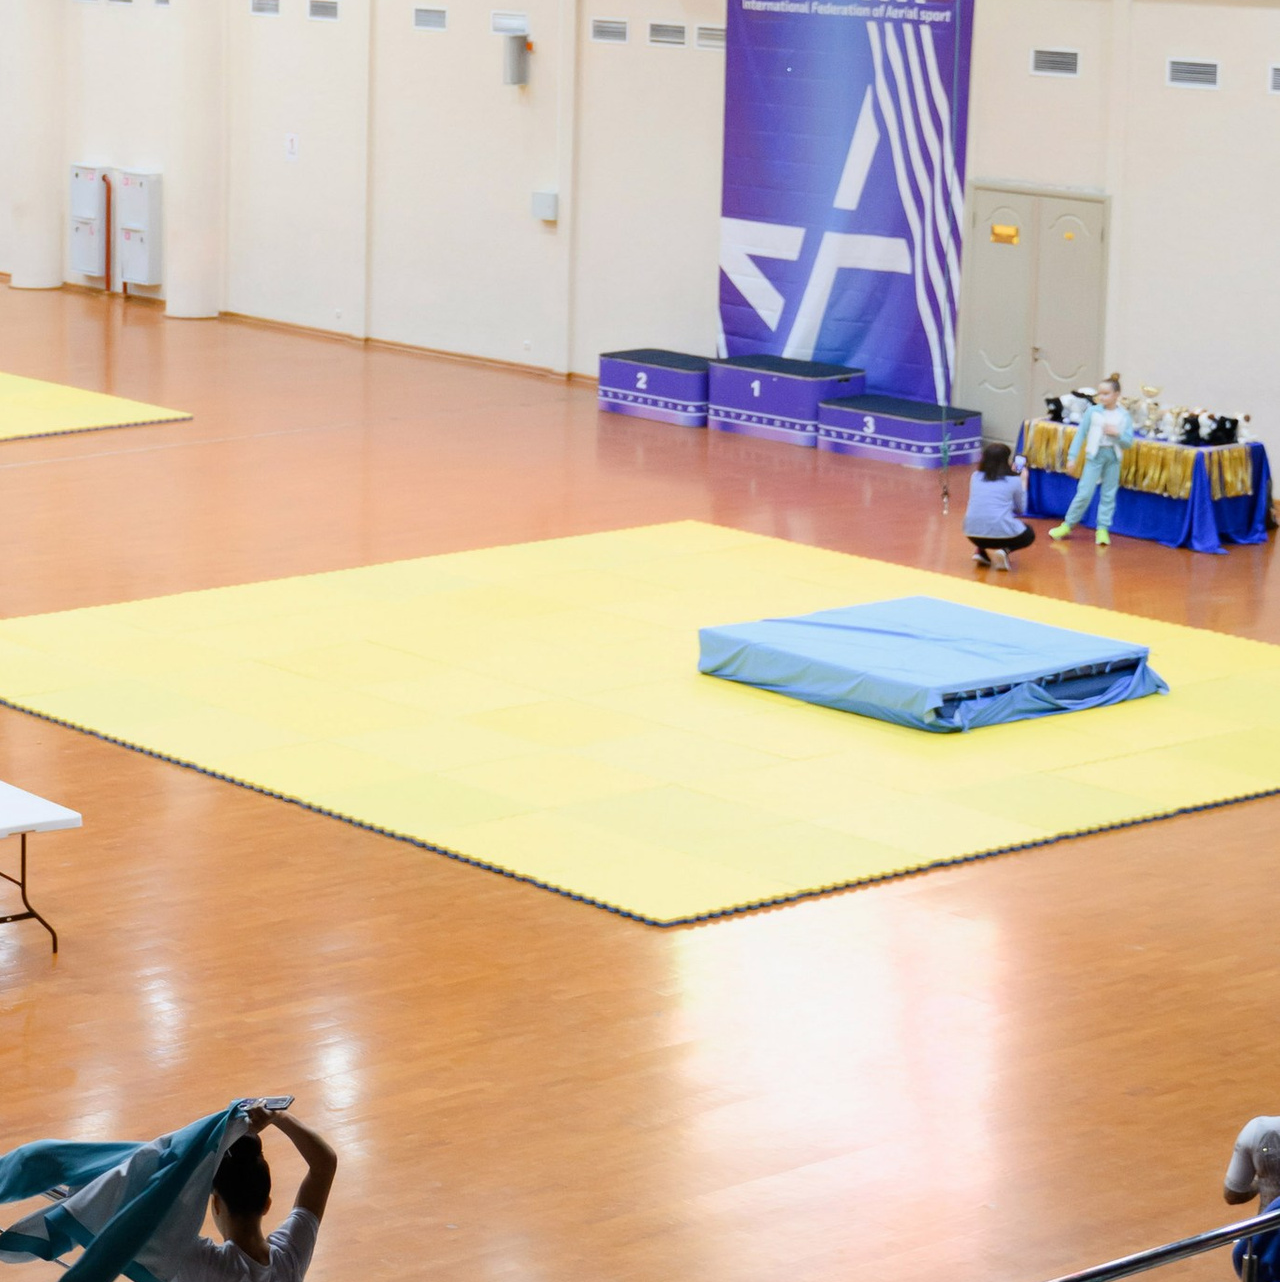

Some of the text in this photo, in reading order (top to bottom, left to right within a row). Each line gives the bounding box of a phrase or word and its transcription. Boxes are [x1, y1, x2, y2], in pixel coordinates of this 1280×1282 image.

[811, 1, 871, 17] Federation
[872, 4, 886, 18] of
[886, 5, 919, 20] Aerial
[919, 9, 952, 24] sport
[635, 371, 648, 390] 2
[750, 379, 761, 397] 1
[862, 415, 876, 435] 3
